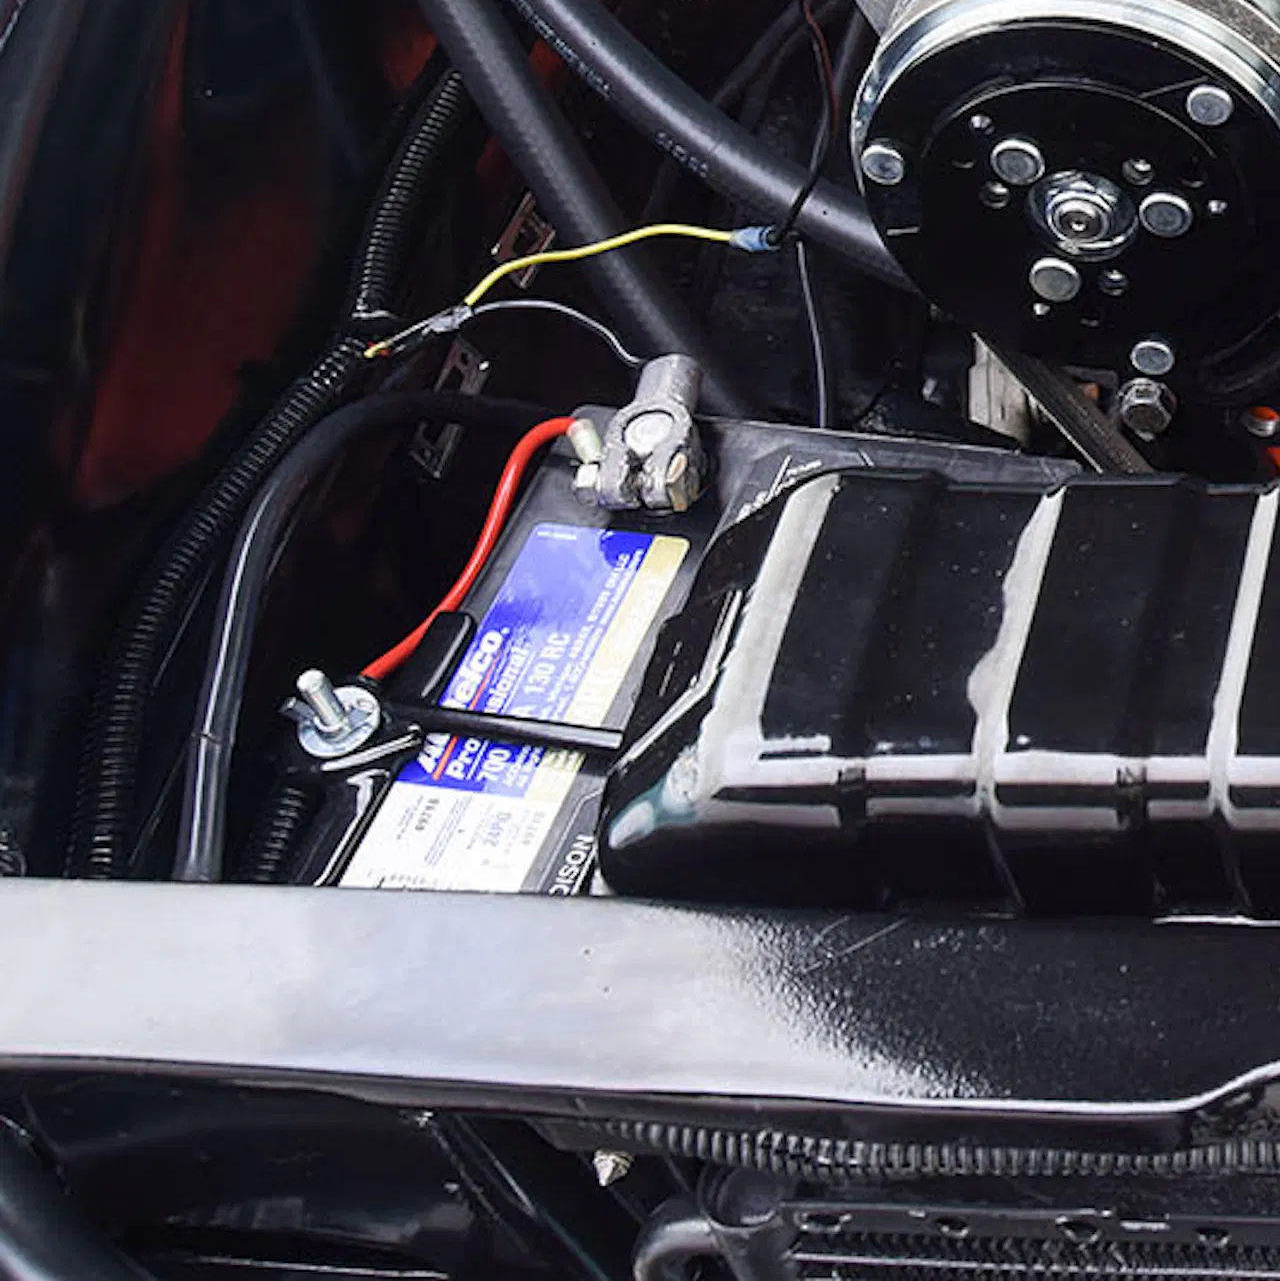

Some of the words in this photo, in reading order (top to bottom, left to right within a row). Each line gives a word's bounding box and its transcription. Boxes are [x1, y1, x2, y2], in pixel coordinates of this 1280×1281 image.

[477, 746, 511, 784] 700
[524, 661, 555, 697] 130
[548, 631, 571, 660] RC
